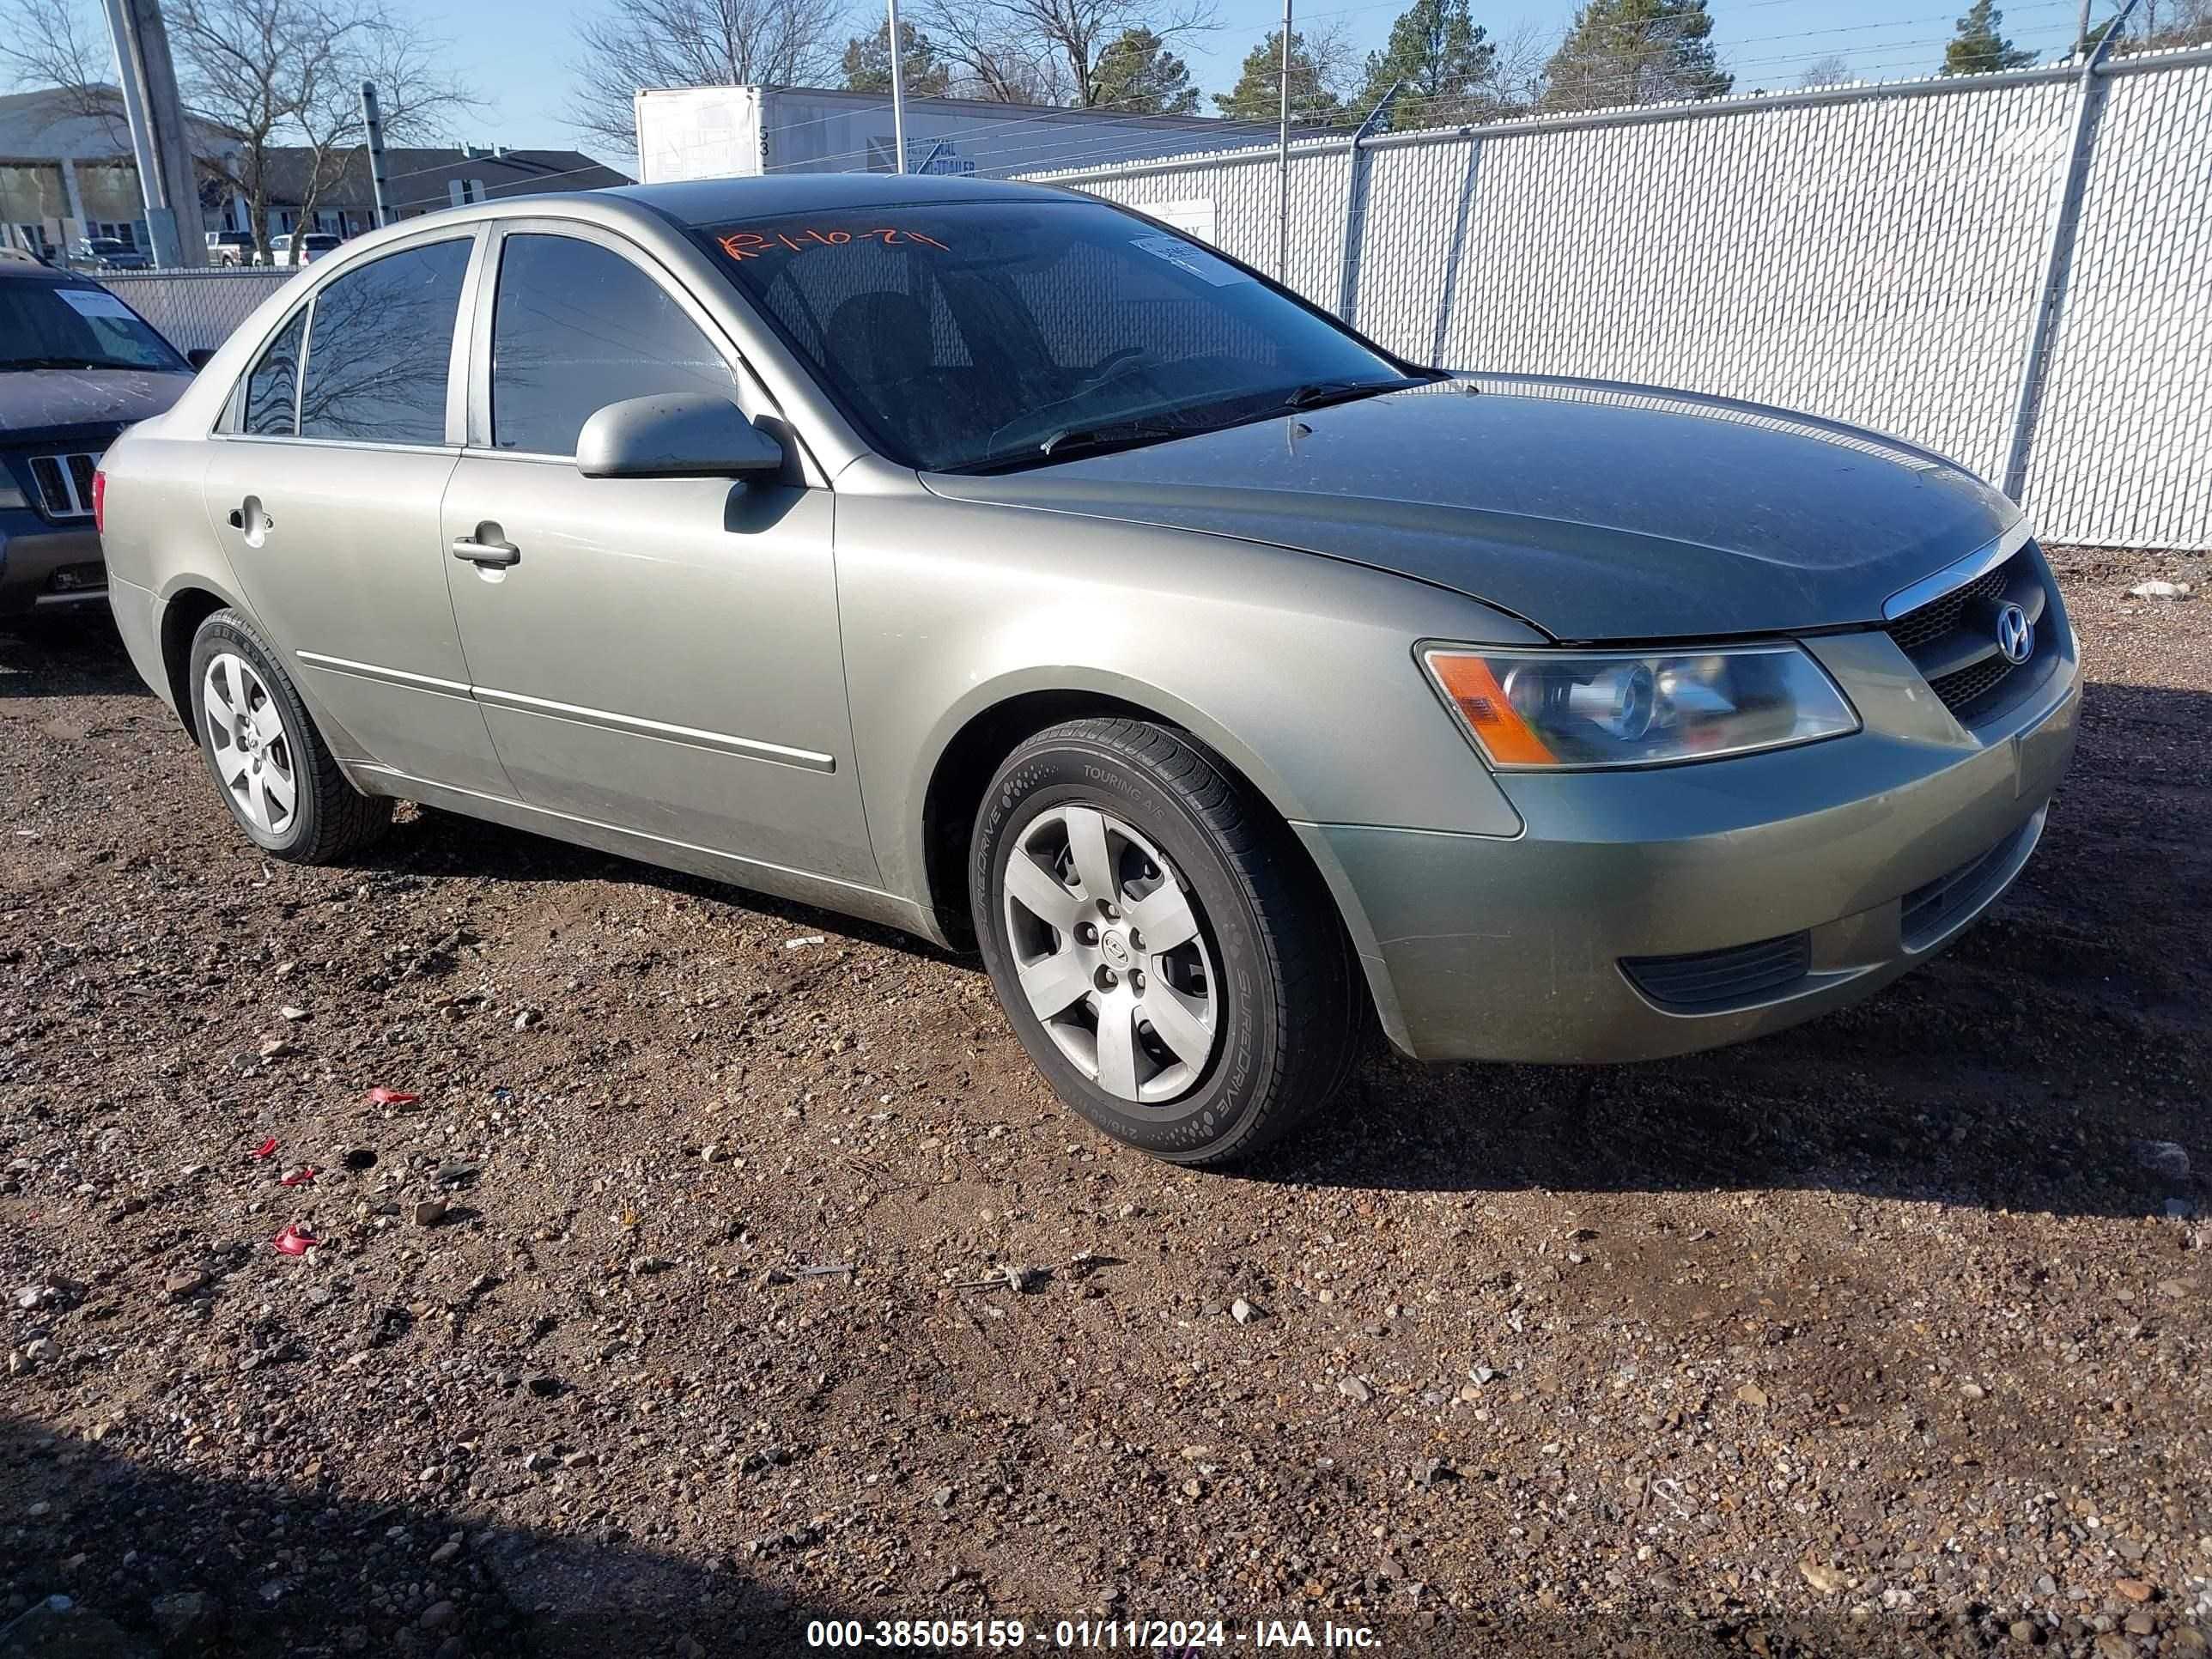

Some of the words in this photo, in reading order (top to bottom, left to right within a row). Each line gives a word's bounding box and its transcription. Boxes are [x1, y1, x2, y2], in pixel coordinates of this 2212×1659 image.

[1085, 764, 1141, 799] TOURING
[1145, 798, 1164, 817] A/S
[975, 805, 1002, 942] SUREDRIVE
[1216, 968, 1253, 1119] SUREDRIVE
